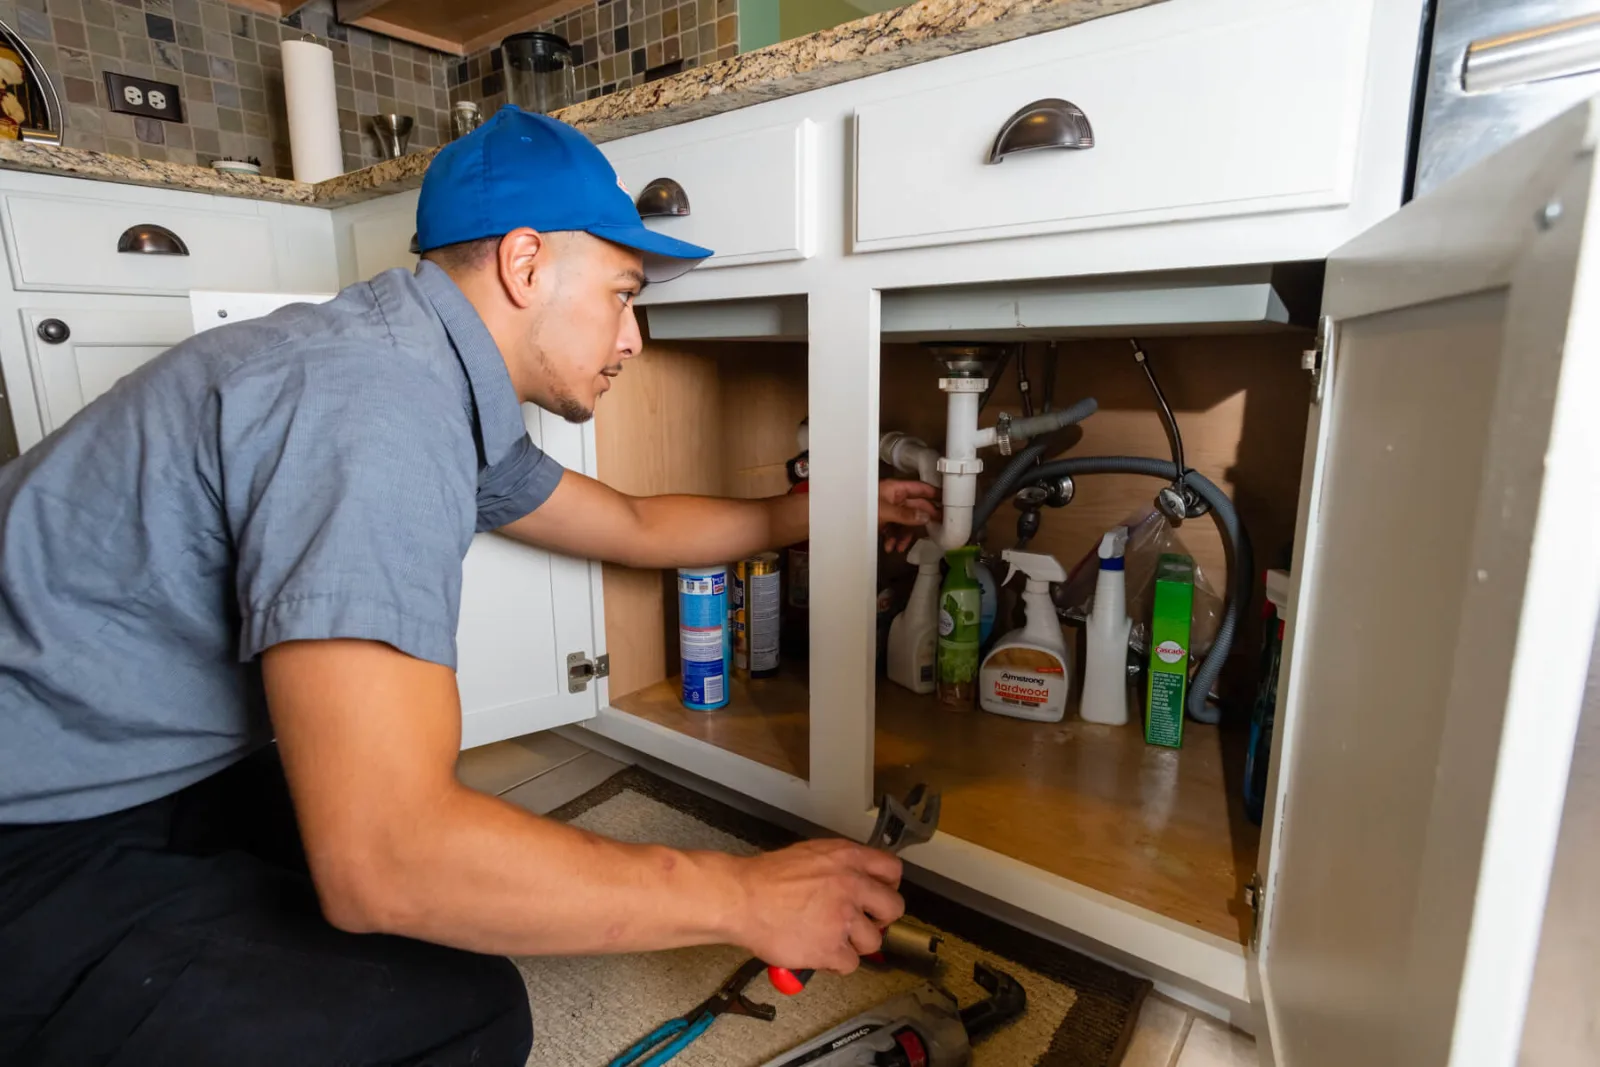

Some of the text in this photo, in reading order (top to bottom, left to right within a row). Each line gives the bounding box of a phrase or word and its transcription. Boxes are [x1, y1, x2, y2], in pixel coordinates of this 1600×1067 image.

[1154, 645, 1186, 655] Cascade
[1001, 671, 1045, 686] Armstrong
[994, 680, 1049, 697] hardwood
[832, 1031, 861, 1049] HUSKY
